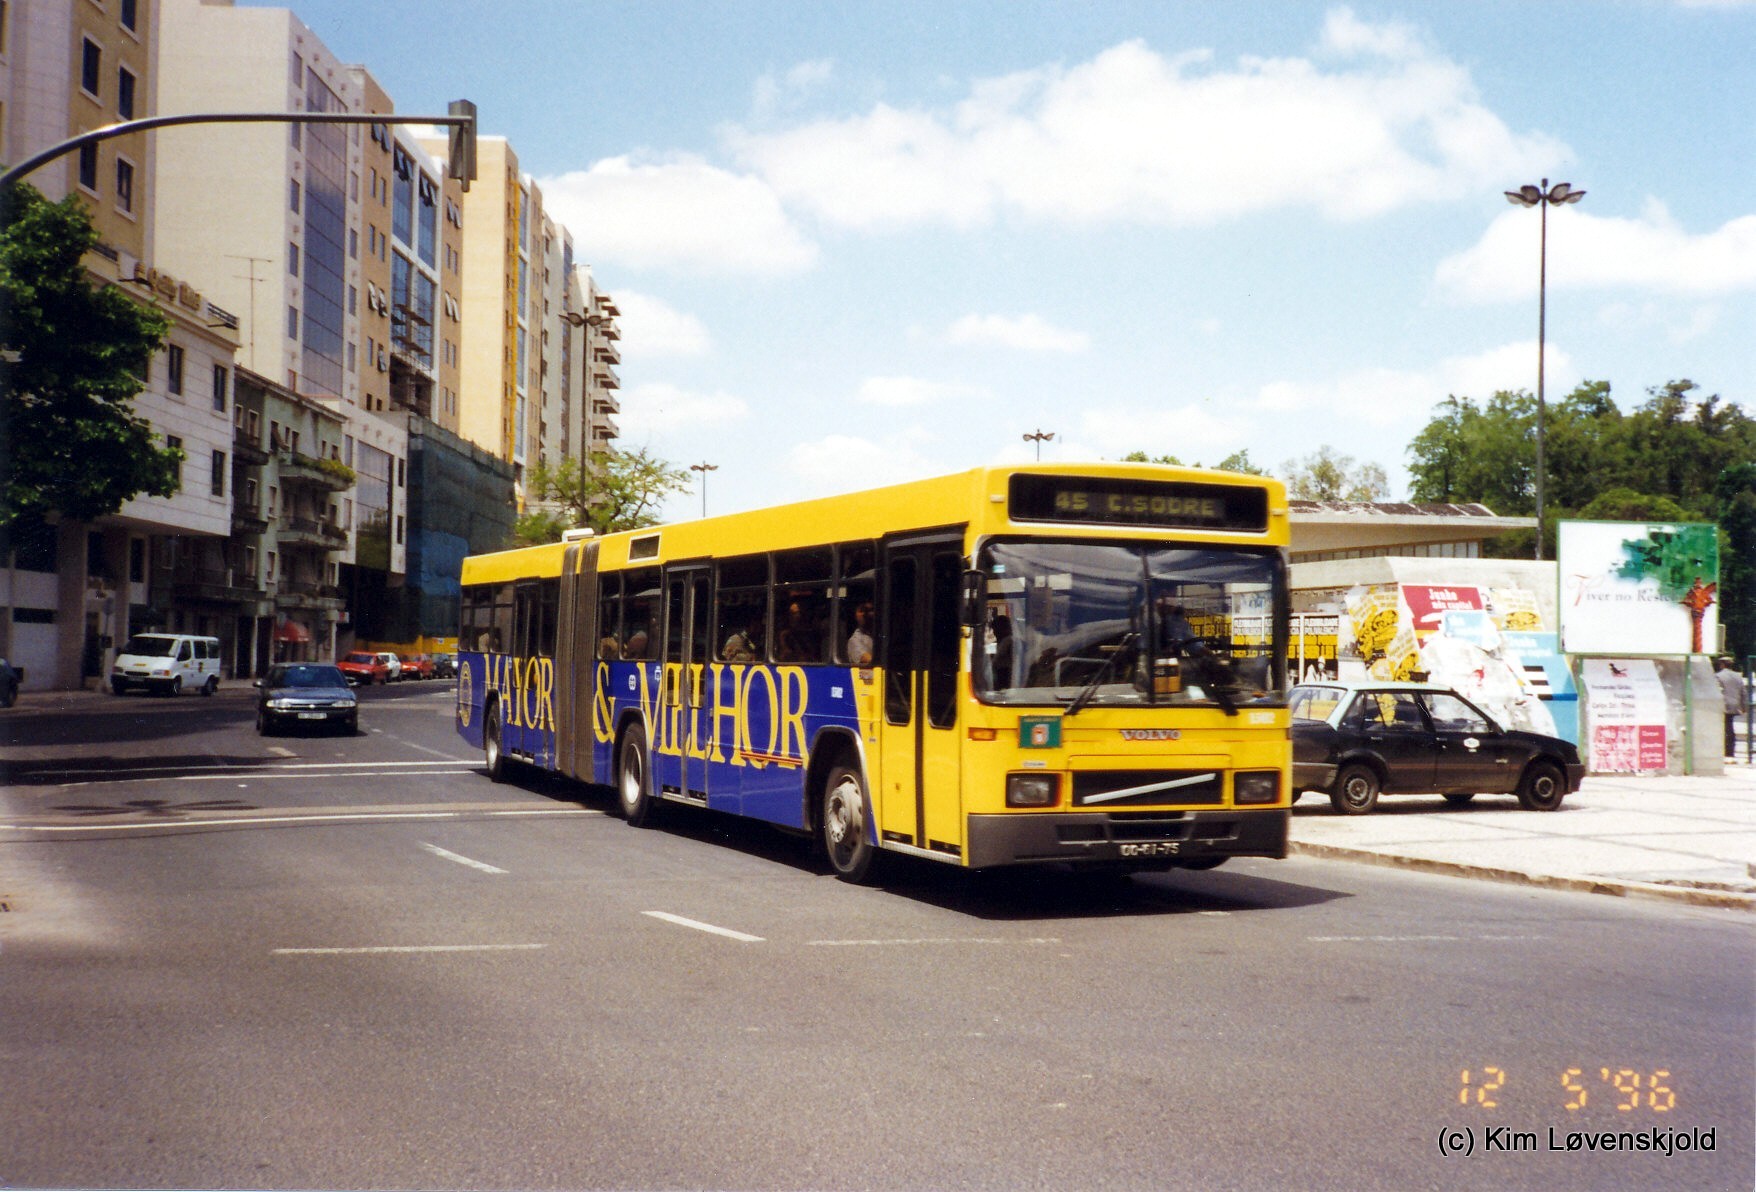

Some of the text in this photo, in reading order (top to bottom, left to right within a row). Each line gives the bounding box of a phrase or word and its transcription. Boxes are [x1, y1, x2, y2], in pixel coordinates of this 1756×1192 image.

[1056, 491, 1215, 516] 45 C.SODRE
[483, 653, 555, 732] MAYOR
[593, 662, 616, 744] &
[636, 661, 810, 771] MELHOR
[1121, 729, 1181, 741] VOLVO
